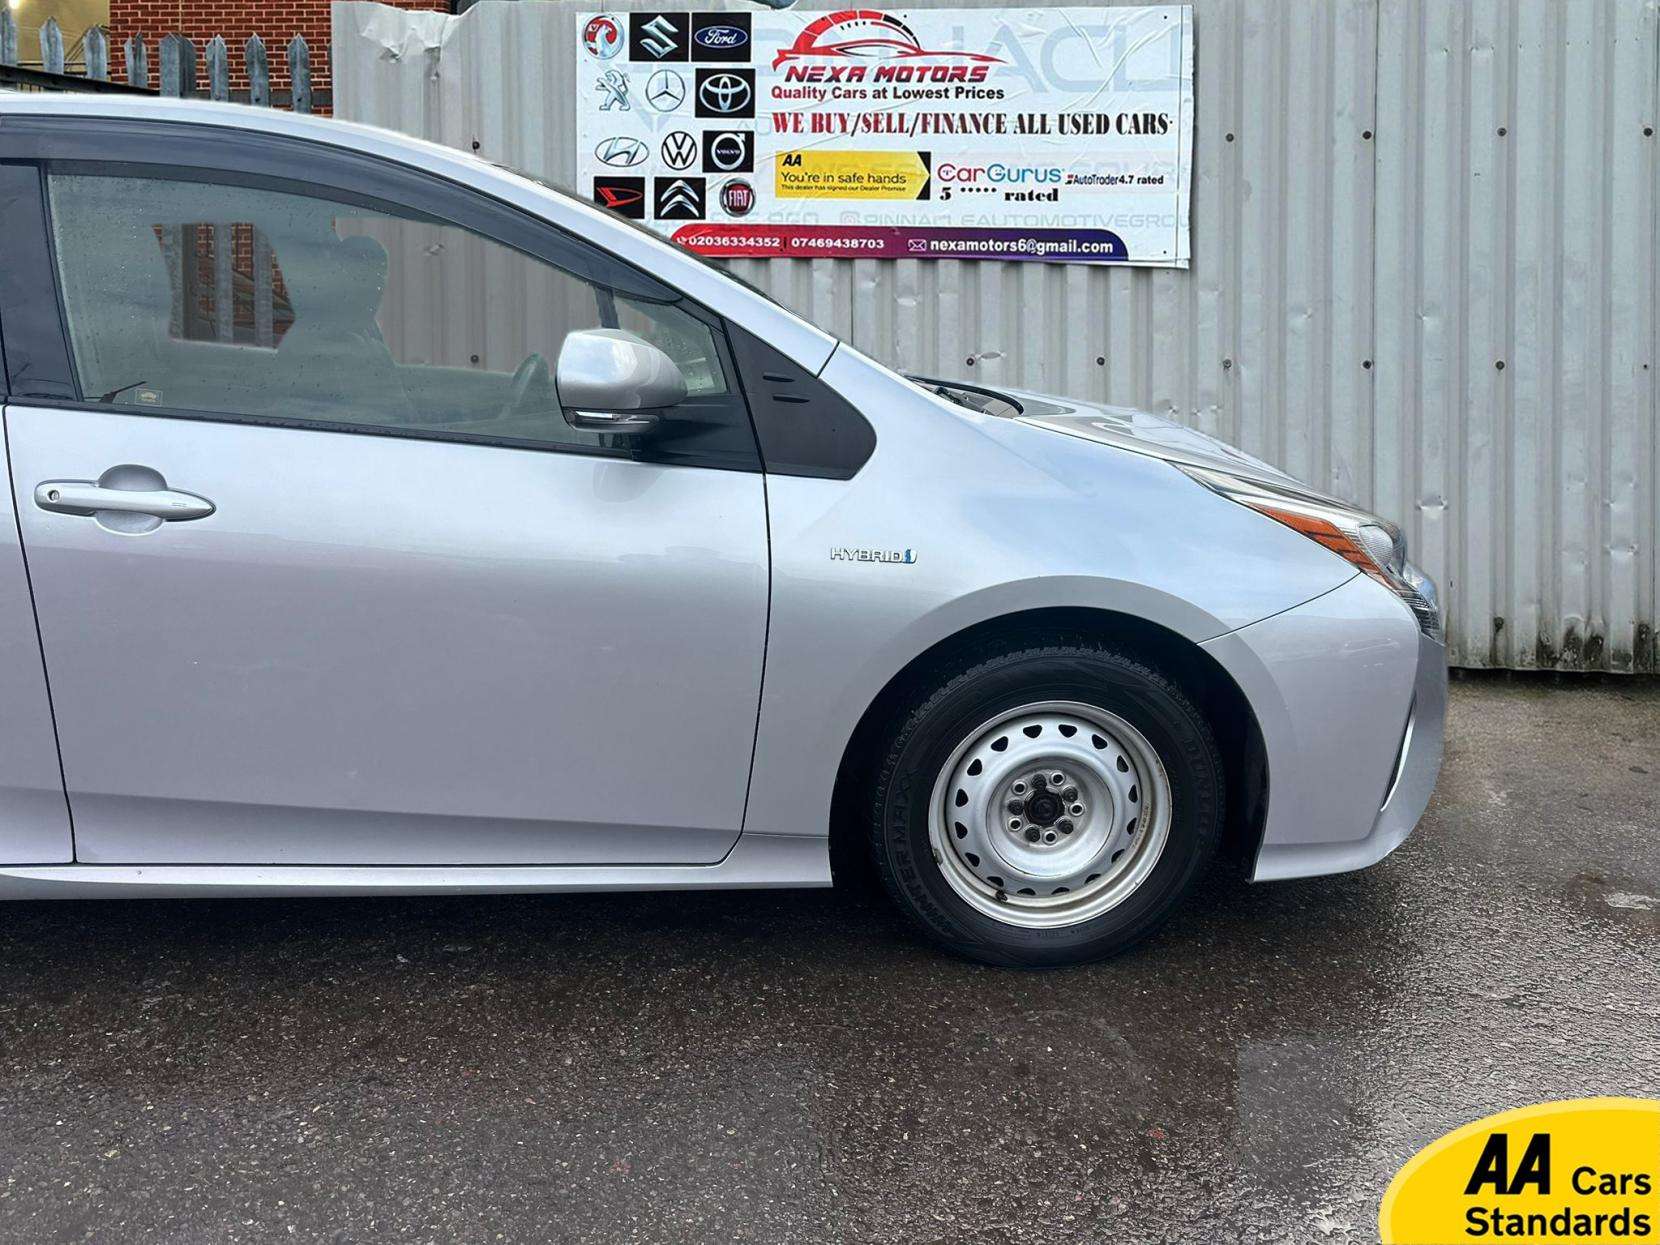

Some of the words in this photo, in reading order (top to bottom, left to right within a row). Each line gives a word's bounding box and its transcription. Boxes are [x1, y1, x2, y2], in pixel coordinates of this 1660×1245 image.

[704, 29, 737, 44] Ford
[785, 66, 867, 83] NEXA
[874, 66, 989, 83] MOTORS
[771, 86, 826, 101] Quality
[832, 87, 868, 99] Cars
[872, 87, 888, 99] at
[893, 87, 950, 99] Lowest
[955, 87, 1005, 99] Prices
[772, 112, 804, 134] WE
[811, 112, 1007, 137] BUY/SELL/FINANCE
[1013, 113, 1051, 135] ALL
[1058, 113, 1110, 135] USED
[1116, 113, 1169, 135] CARS
[782, 153, 802, 167] AA
[781, 172, 820, 183] You're
[823, 173, 835, 183] in
[838, 173, 864, 184] safe
[867, 173, 907, 184] hands
[937, 163, 1062, 182] CarGurus
[1119, 175, 1134, 185] 4.7
[1137, 175, 1164, 184] rated
[728, 190, 749, 207] FIAT
[939, 187, 952, 200] 5
[1004, 188, 1059, 201] rated
[689, 237, 781, 247] 02036334352
[791, 238, 885, 249] 07469438703
[930, 239, 1113, 254] nexamotors6@gmail.com
[830, 547, 903, 563] HYBRID
